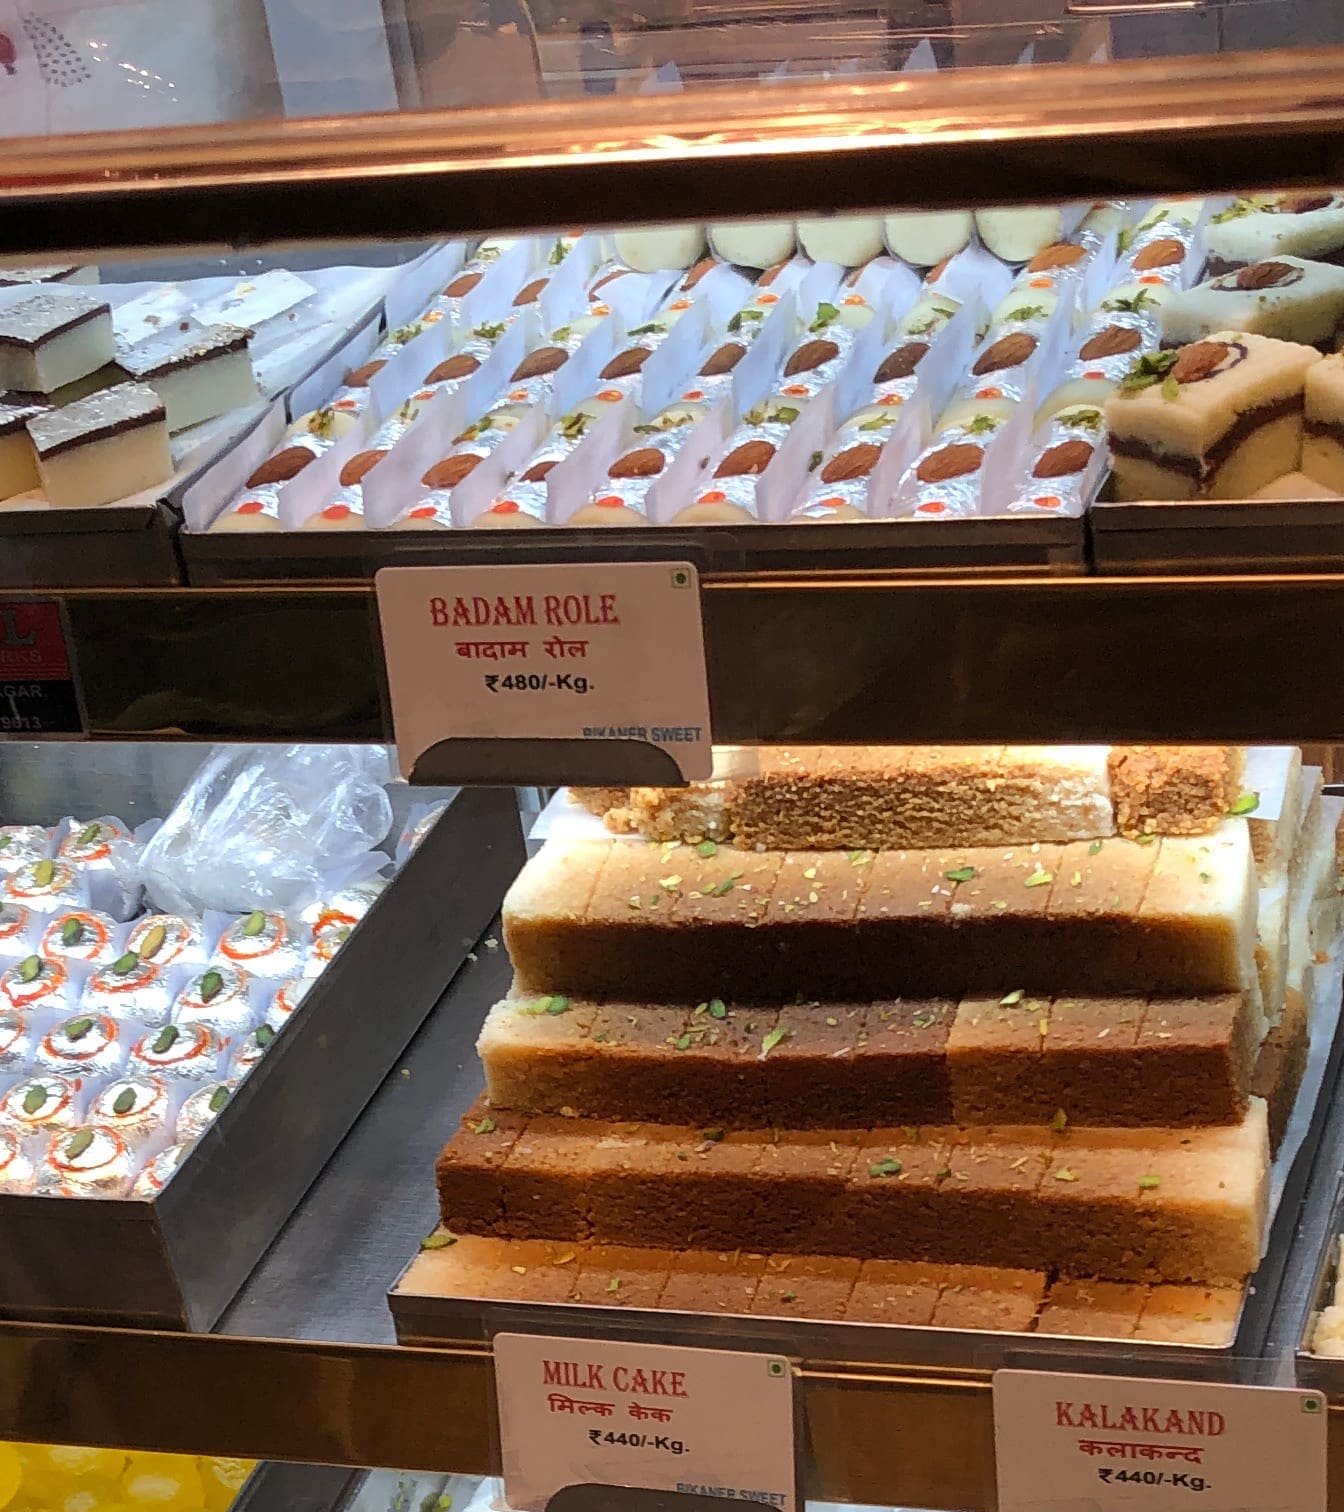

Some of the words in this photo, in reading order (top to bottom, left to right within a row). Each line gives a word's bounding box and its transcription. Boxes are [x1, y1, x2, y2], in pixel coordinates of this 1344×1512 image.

[430, 596, 538, 627] BADAM
[544, 594, 620, 626] ROLE
[455, 640, 529, 659] बादाम
[543, 635, 588, 658] रोल
[485, 674, 594, 693] ₹480/-Kg.
[652, 727, 702, 743] SWEET
[543, 1360, 605, 1390] MILK
[613, 1366, 690, 1398] CAKE
[547, 1393, 616, 1417] मिल्क
[628, 1402, 674, 1423] केक
[1056, 1401, 1226, 1437] KALAKAND
[588, 1429, 690, 1455] ₹440/-Kg.
[1078, 1439, 1205, 1464] कलाकन्द
[1098, 1468, 1212, 1491] ₹440/-Kg.
[739, 1488, 787, 1506] SWEET
